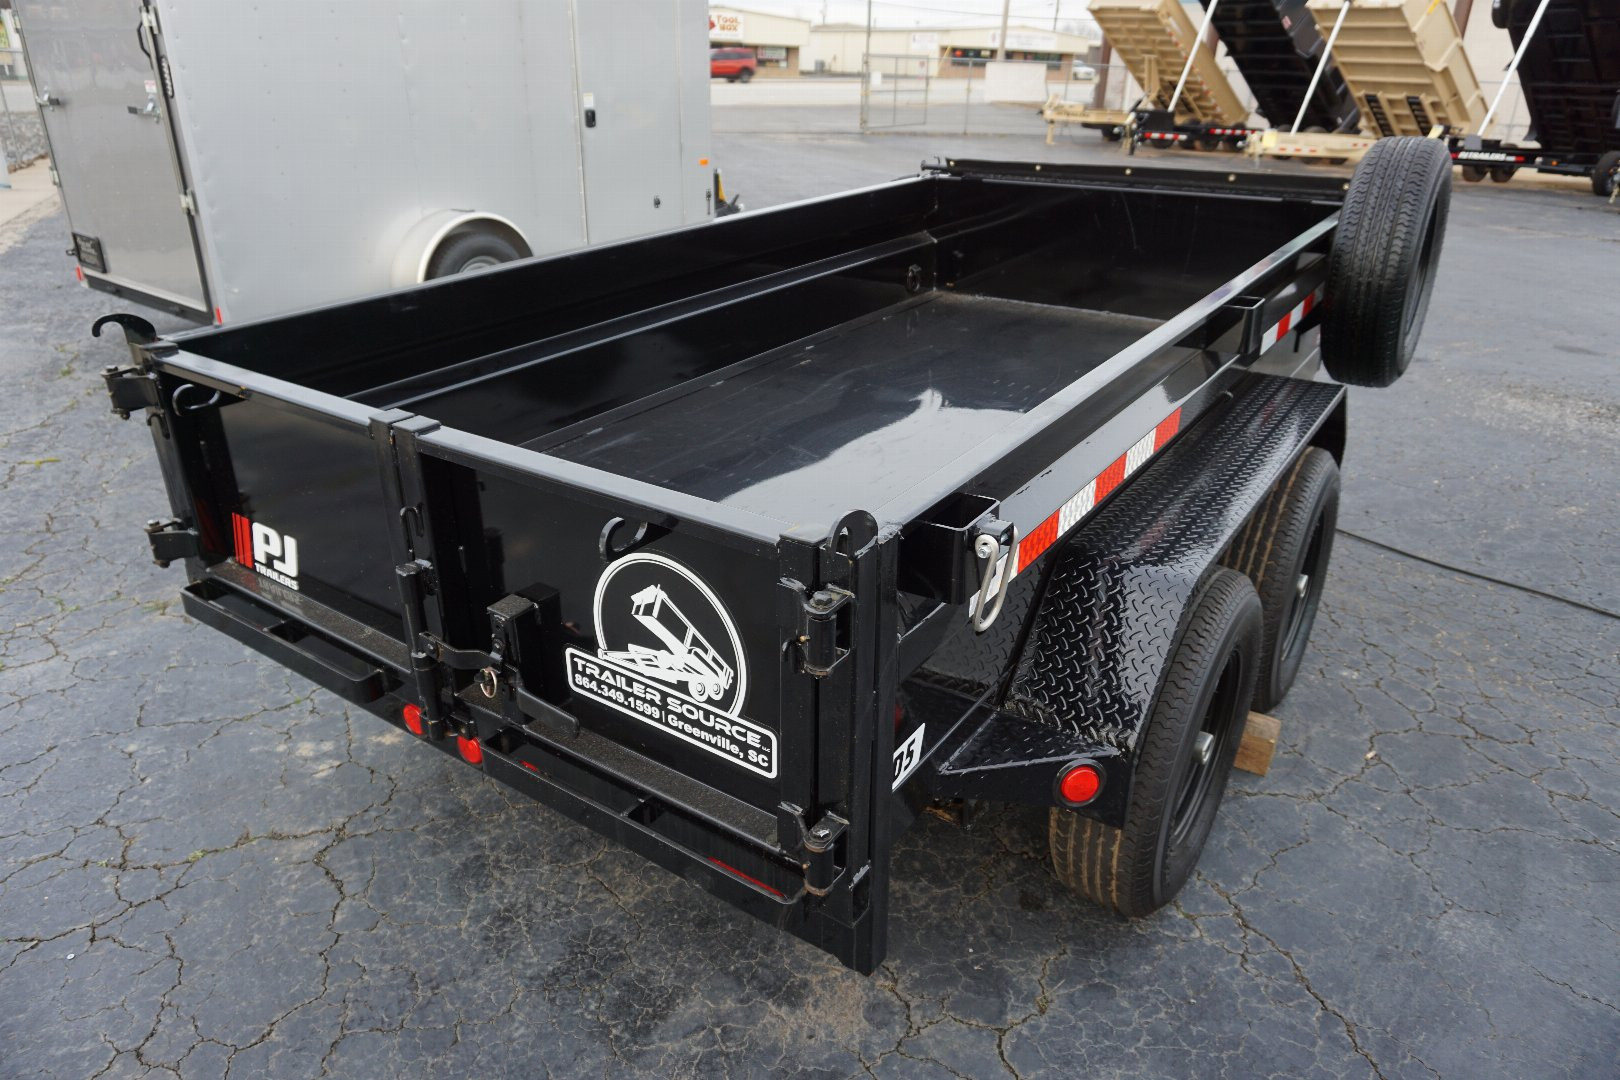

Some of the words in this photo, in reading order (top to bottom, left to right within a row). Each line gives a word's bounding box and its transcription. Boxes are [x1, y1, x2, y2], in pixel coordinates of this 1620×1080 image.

[252, 522, 298, 577] PJ
[254, 562, 299, 591] TRAILERS
[574, 658, 661, 705] TRAILER
[667, 697, 761, 748] SOURCE
[575, 674, 660, 719] 864.349.1599
[668, 714, 744, 759] Greenville,
[748, 750, 768, 767] SC
